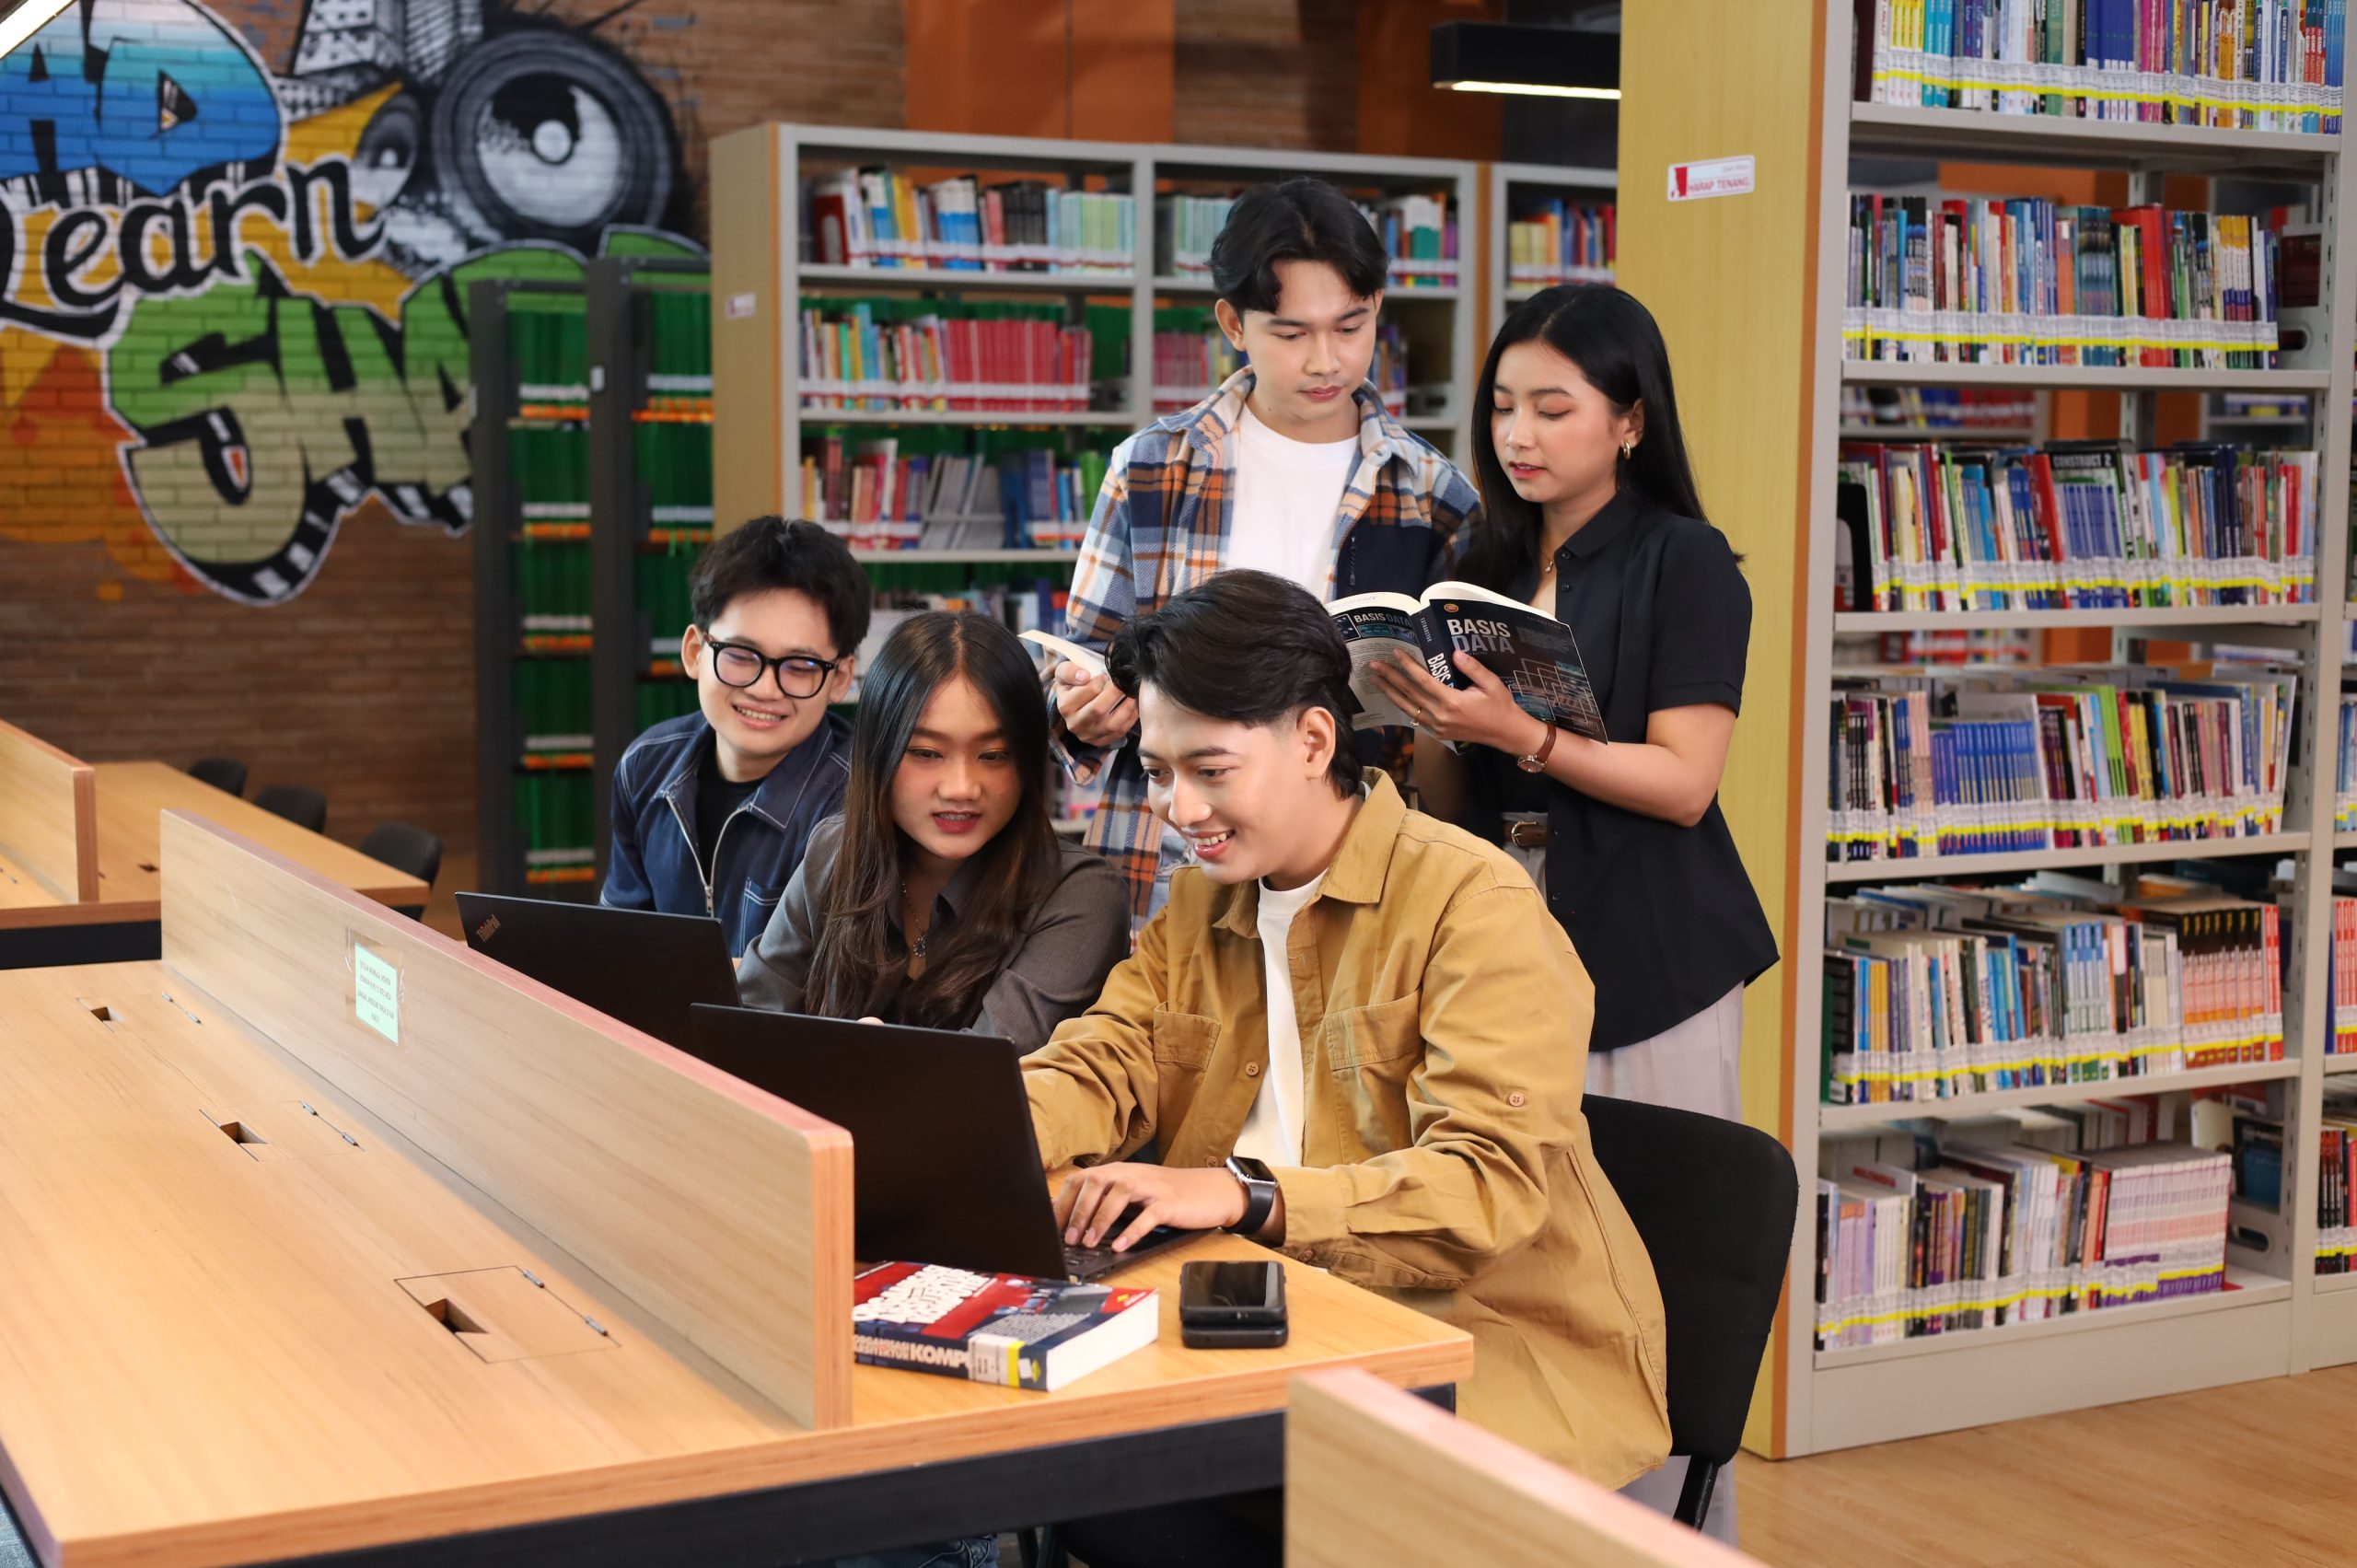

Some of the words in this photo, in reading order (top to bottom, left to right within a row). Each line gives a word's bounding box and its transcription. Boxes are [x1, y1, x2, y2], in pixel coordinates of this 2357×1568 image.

[2104, 453, 2112, 467] 2
[1353, 612, 1386, 623] BASIS
[1386, 614, 1412, 627] DATA
[1446, 619, 1511, 638] BASIS
[1451, 634, 1515, 655] DATA
[1427, 652, 1452, 686] BASIS
[911, 1342, 970, 1369] KOMP
